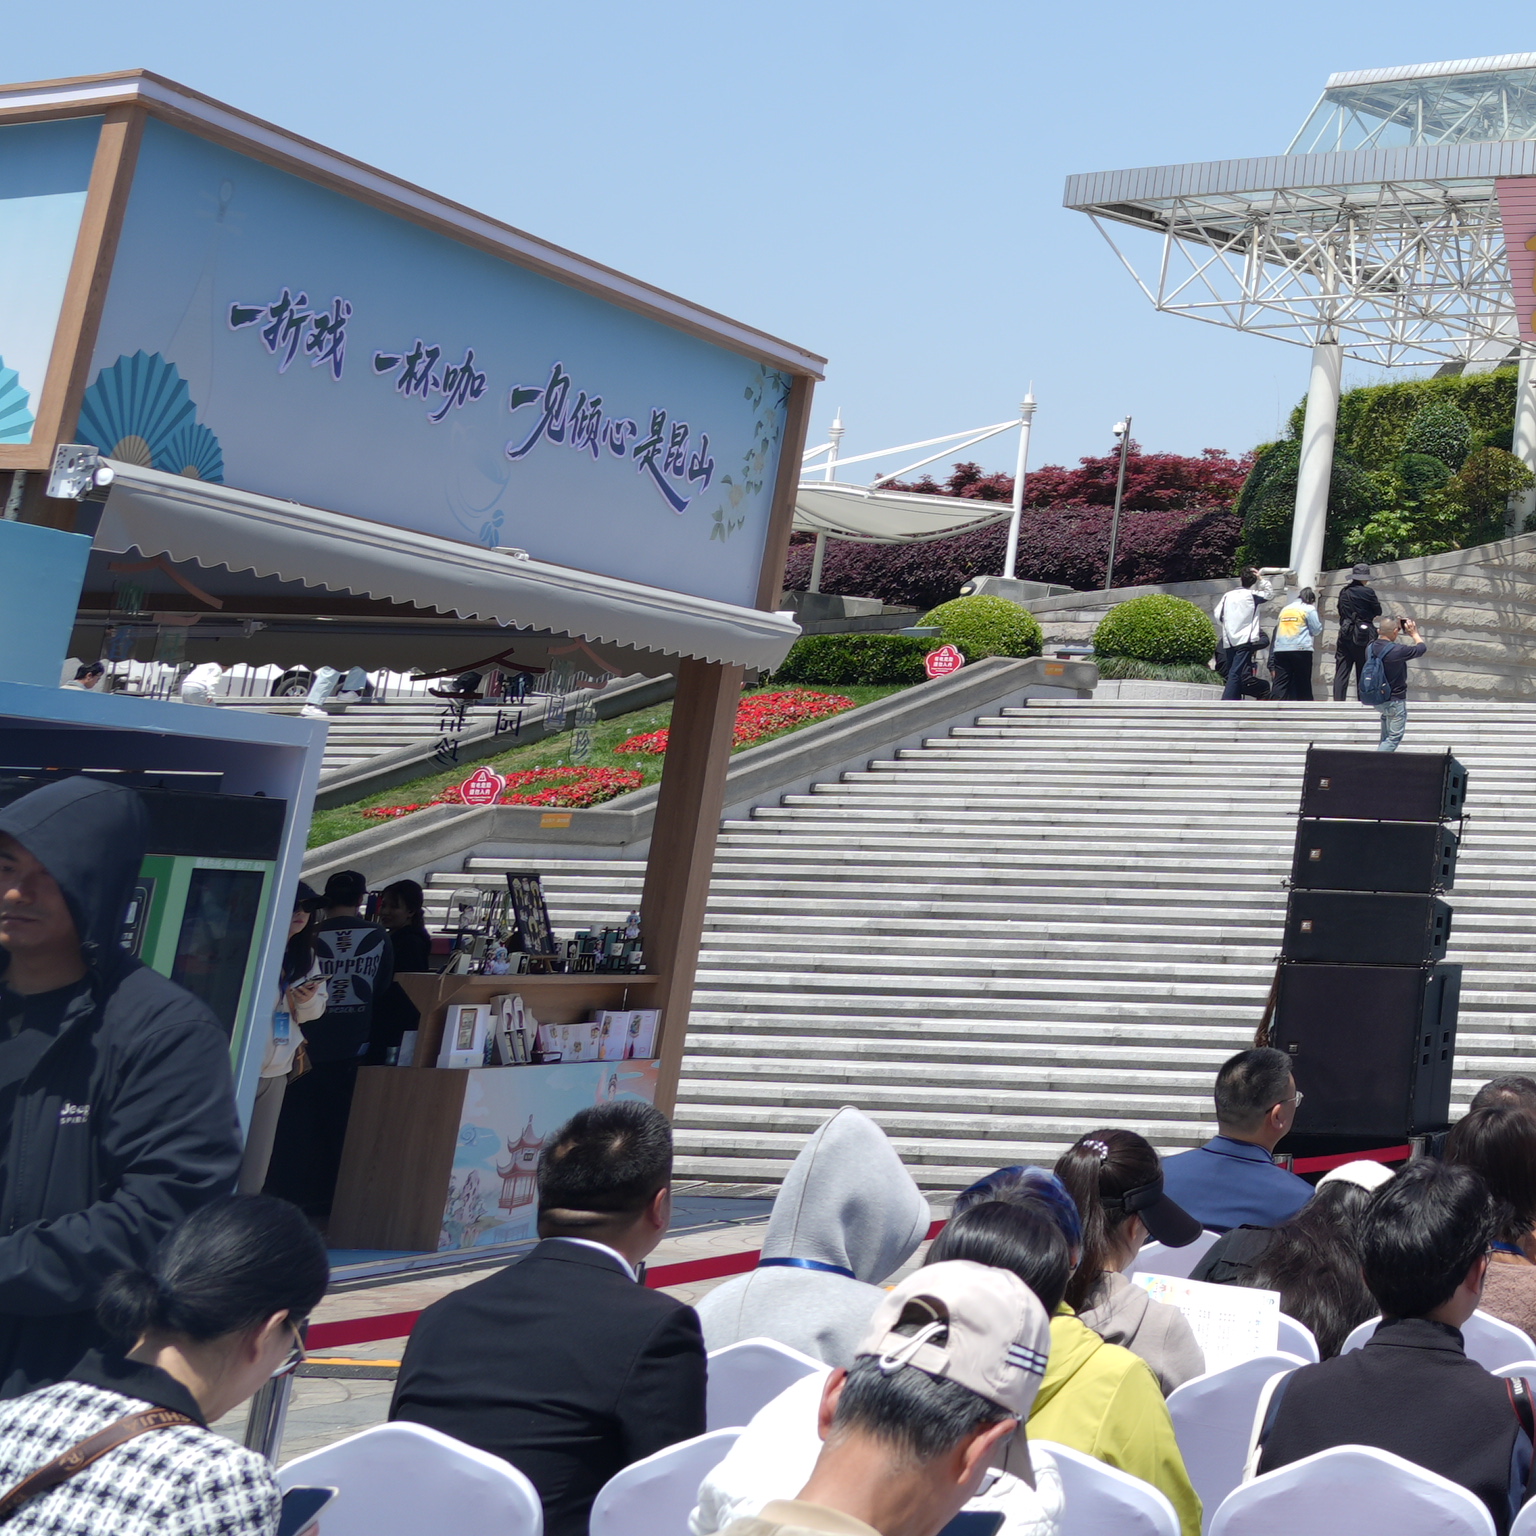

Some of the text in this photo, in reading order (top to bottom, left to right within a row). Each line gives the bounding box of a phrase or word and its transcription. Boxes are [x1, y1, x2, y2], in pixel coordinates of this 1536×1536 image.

[229, 286, 352, 381] 一折戏
[373, 337, 487, 424] 一杯咖
[319, 954, 380, 978] OPPERS
